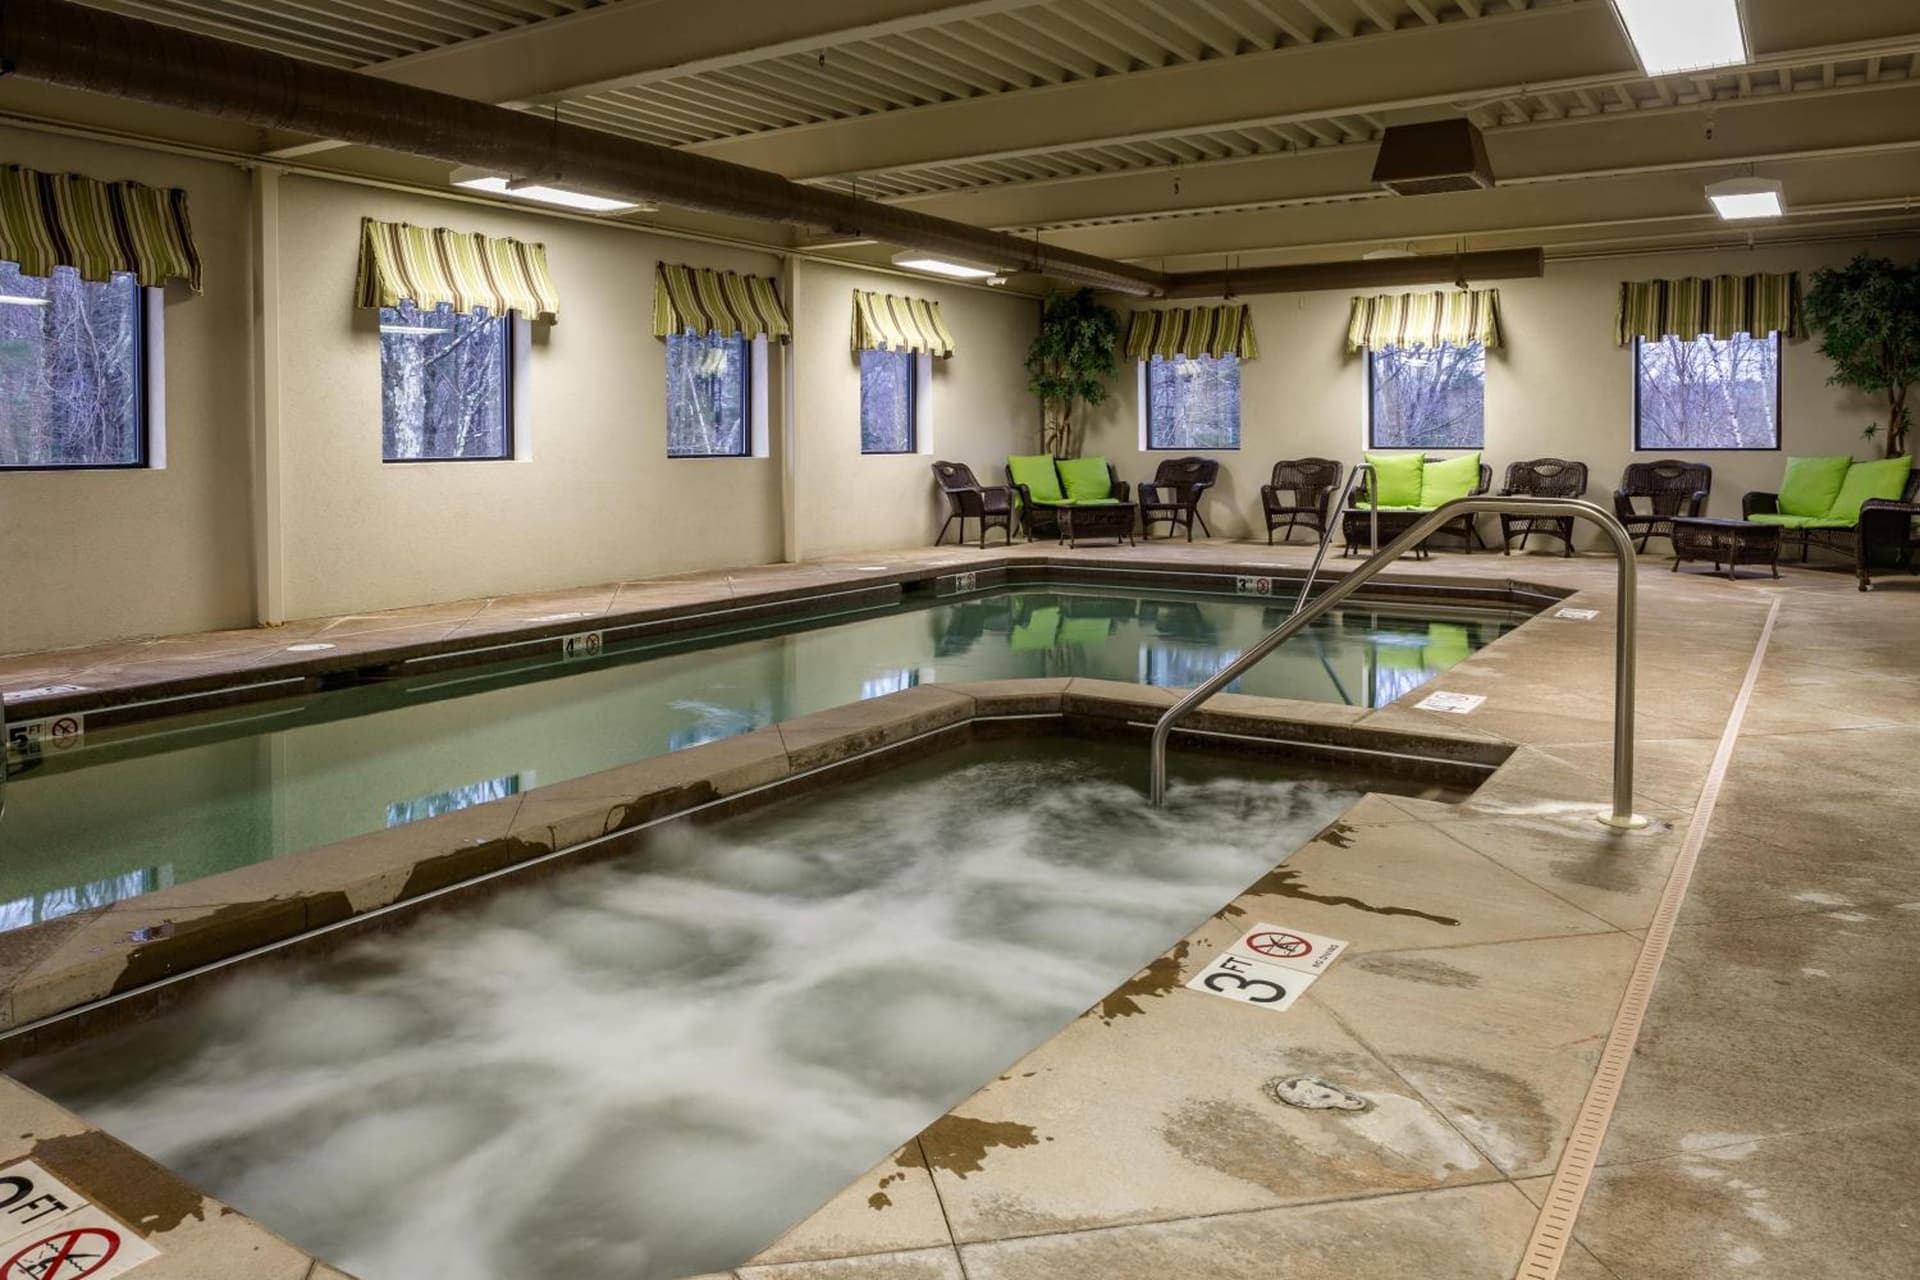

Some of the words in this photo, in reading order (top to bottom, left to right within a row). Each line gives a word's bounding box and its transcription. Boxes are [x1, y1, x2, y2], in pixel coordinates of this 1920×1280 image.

[9, 726, 28, 750] 5
[1220, 956, 1253, 974] FT
[1204, 972, 1287, 1003] 3
[7, 1193, 69, 1225] FT
